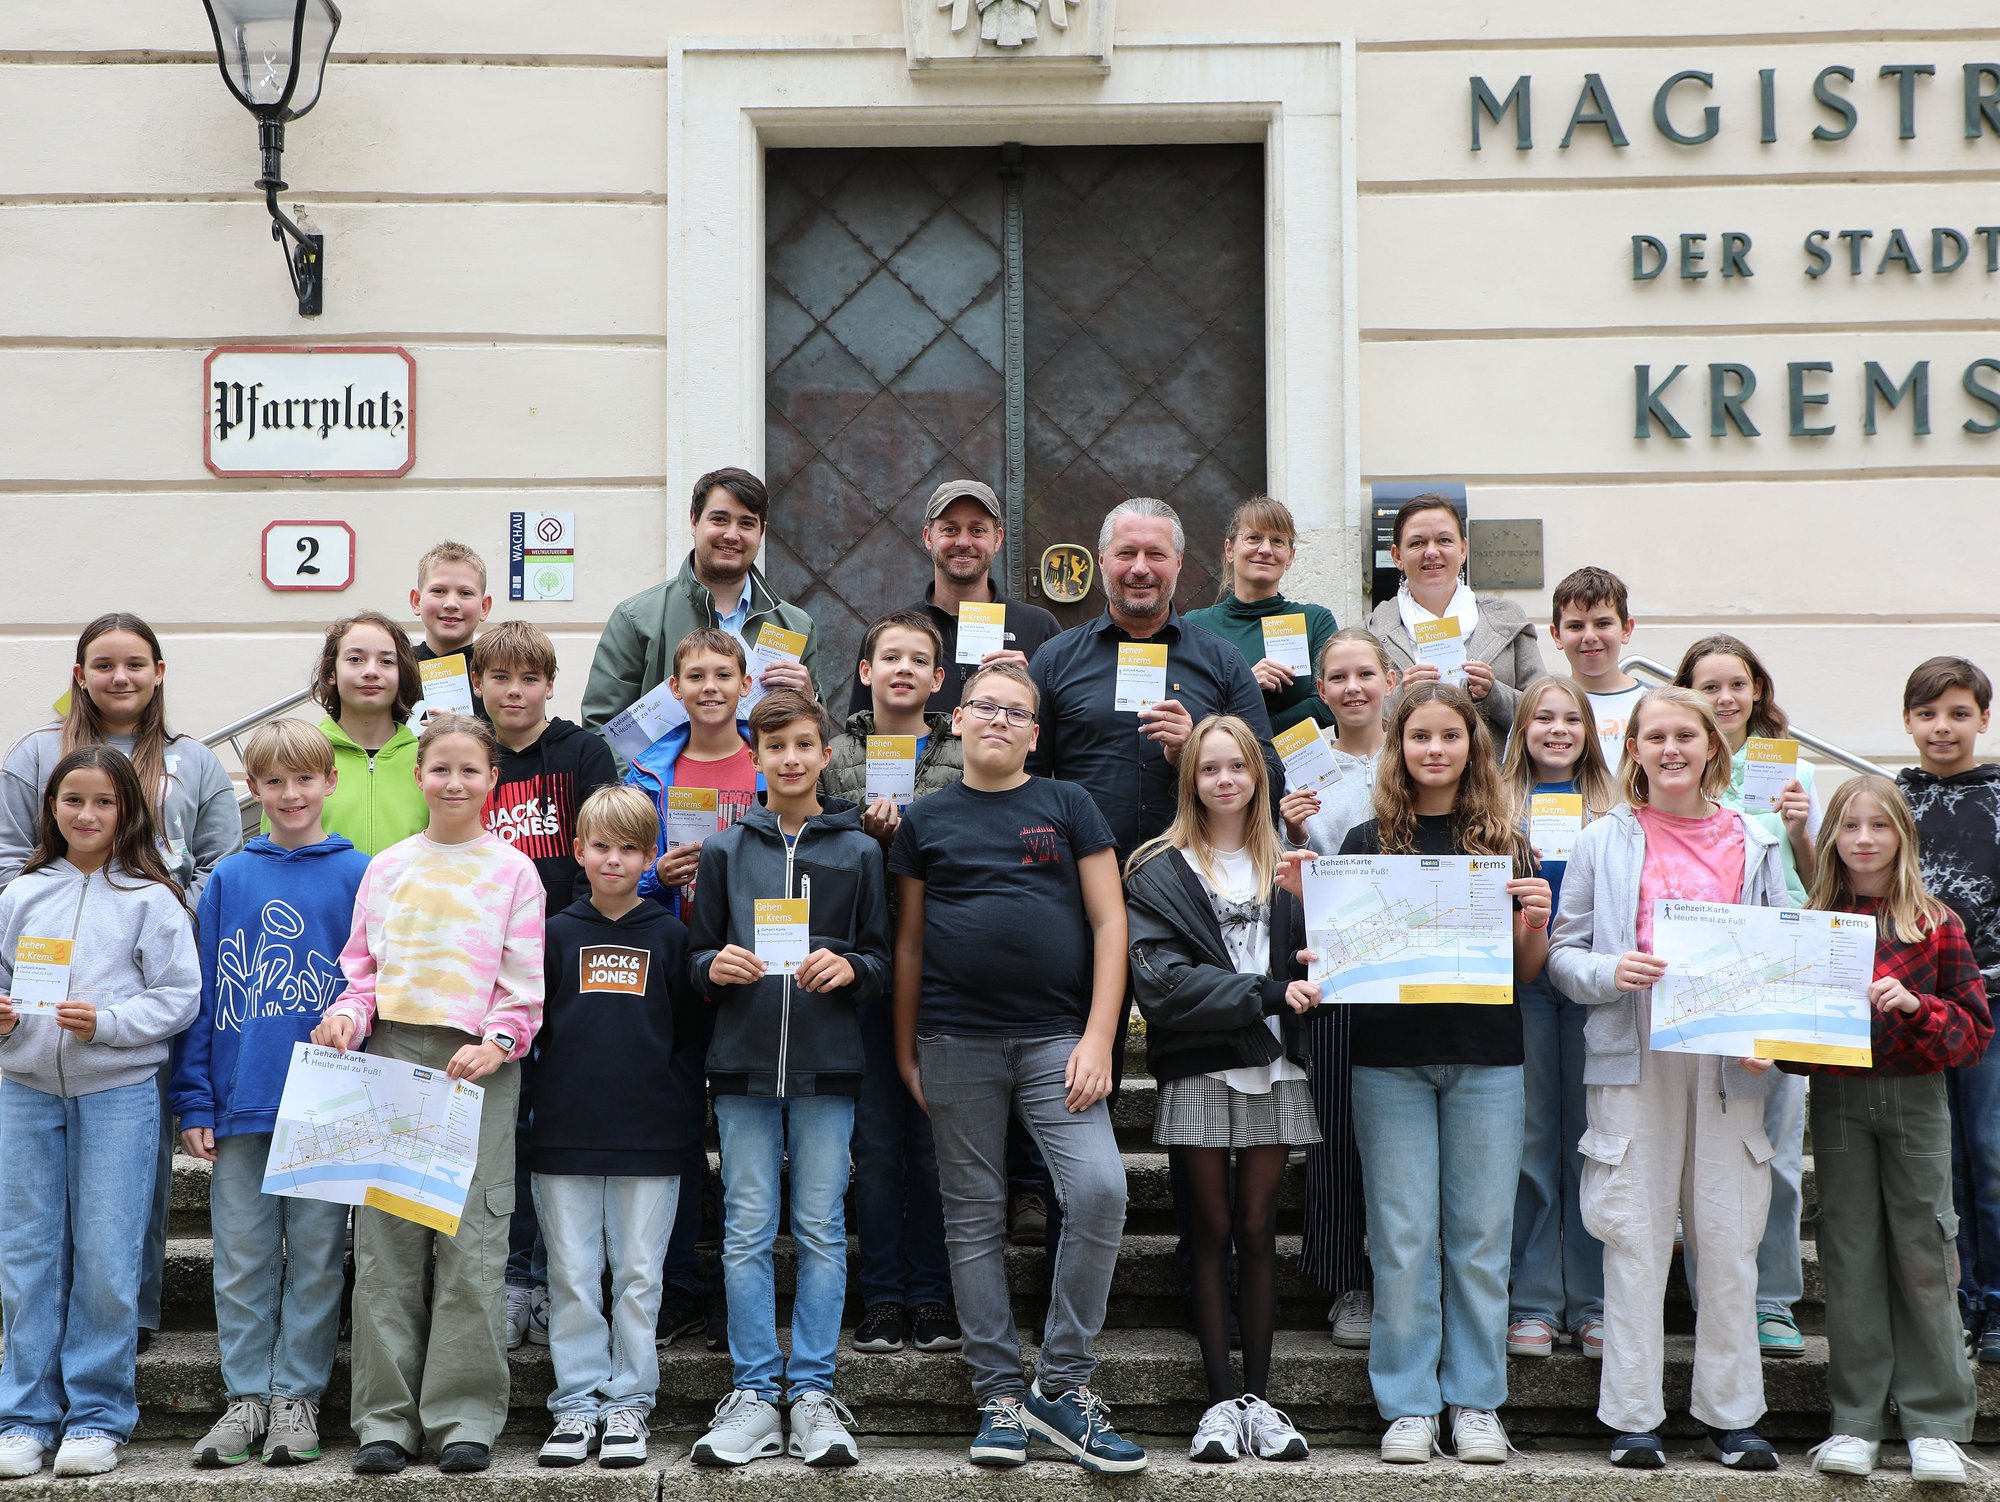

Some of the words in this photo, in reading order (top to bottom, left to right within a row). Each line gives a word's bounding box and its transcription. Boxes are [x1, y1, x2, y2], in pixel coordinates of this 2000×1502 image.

[1470, 63, 2000, 151] MAGISTR
[1632, 232, 1754, 280] DER
[1804, 227, 2000, 279] STADT
[1634, 358, 2000, 439] KREMS
[512, 514, 523, 562] WACHAU
[296, 536, 321, 575] 2
[763, 627, 785, 639] Gehen
[1272, 627, 1293, 635] Krems
[1415, 623, 1438, 633] Gehen
[1426, 631, 1448, 640] Krems
[768, 638, 790, 651] Krems
[1119, 645, 1143, 654] Gehen
[1127, 656, 1152, 664] Krems
[420, 662, 443, 671] Gehen
[430, 669, 452, 678] Krems
[867, 739, 892, 747] Gehen
[1274, 733, 1295, 748] Gehen
[1285, 737, 1307, 752] Krems
[1748, 741, 1774, 750] Gehen
[877, 749, 901, 757] Krems
[1757, 751, 1783, 760] Krems
[668, 789, 693, 799] Gehen
[678, 800, 701, 808] Krems
[702, 792, 714, 808] 2
[1533, 796, 1557, 804] Gehen
[1541, 805, 1566, 814] Krems
[1319, 858, 1372, 867] Gehzeit.Karte
[1473, 859, 1506, 869] krems
[755, 902, 782, 911] Gehen
[1674, 903, 1730, 914] Gehzeit.Karte
[756, 914, 763, 922] in
[766, 913, 792, 922] Krems
[1674, 914, 1698, 922] Heute
[1700, 915, 1715, 923] mal
[1728, 917, 1746, 926] Fuß!
[1834, 915, 1869, 928] krems
[19, 940, 46, 950] Gehen
[16, 951, 25, 959] in
[27, 952, 54, 961] Krems
[54, 941, 66, 961] 3
[588, 970, 638, 985] JONES
[311, 1059, 335, 1069] Heute
[336, 1063, 350, 1071] mal
[363, 1067, 382, 1076] Fuß!
[457, 1081, 479, 1099] krems
